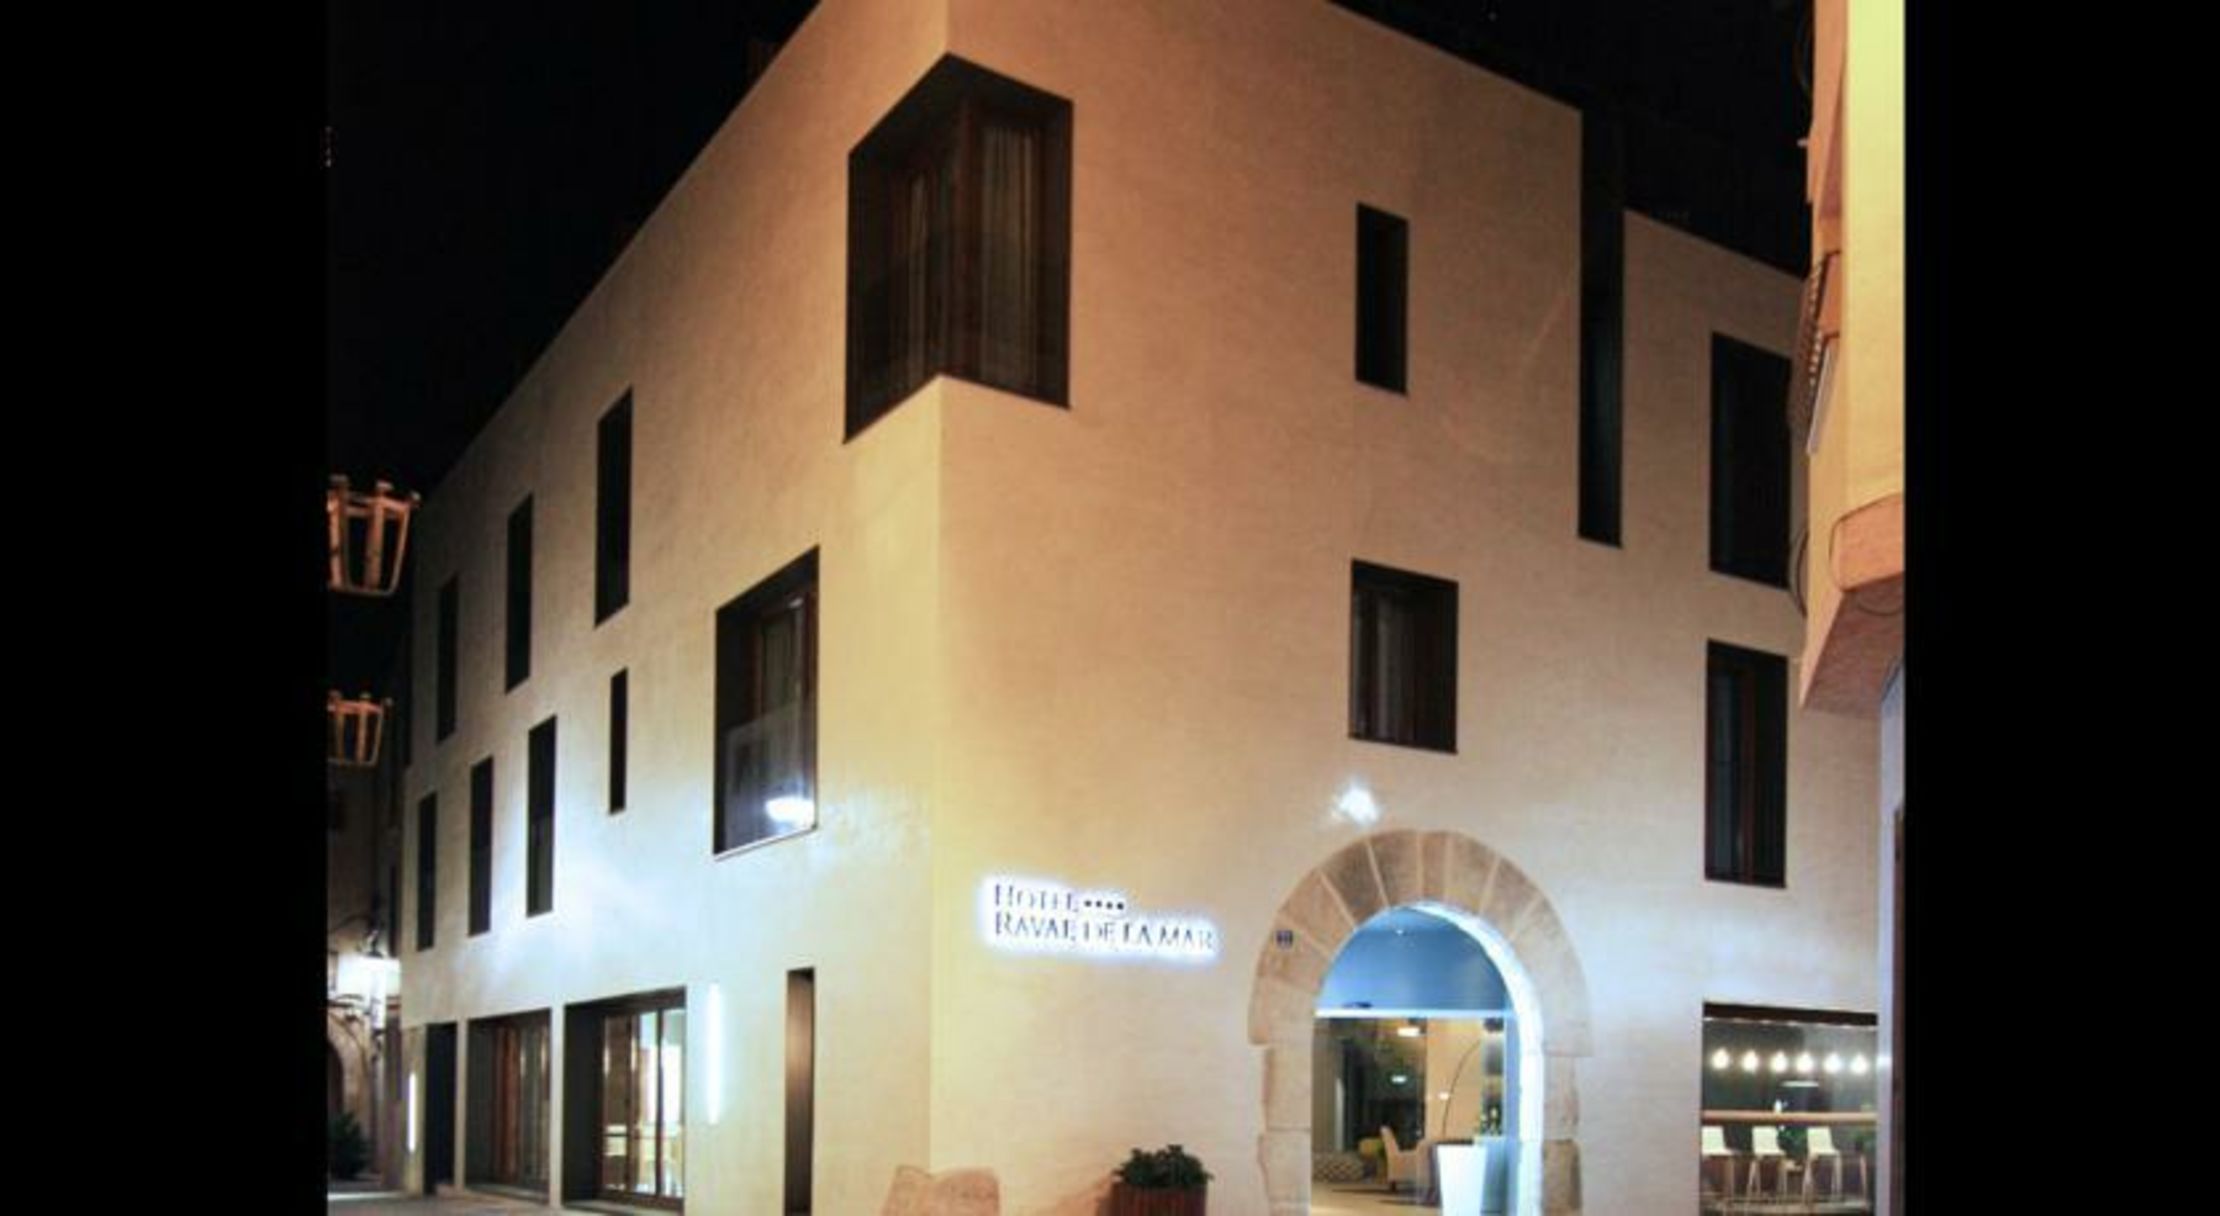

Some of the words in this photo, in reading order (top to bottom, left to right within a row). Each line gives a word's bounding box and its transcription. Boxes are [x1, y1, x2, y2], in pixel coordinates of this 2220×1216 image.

[995, 884, 1079, 912] HOTEL
[995, 911, 1076, 941] RAVAL
[1083, 921, 1116, 942] DE
[1123, 922, 1152, 947] LA
[1159, 925, 1213, 949] MAR
